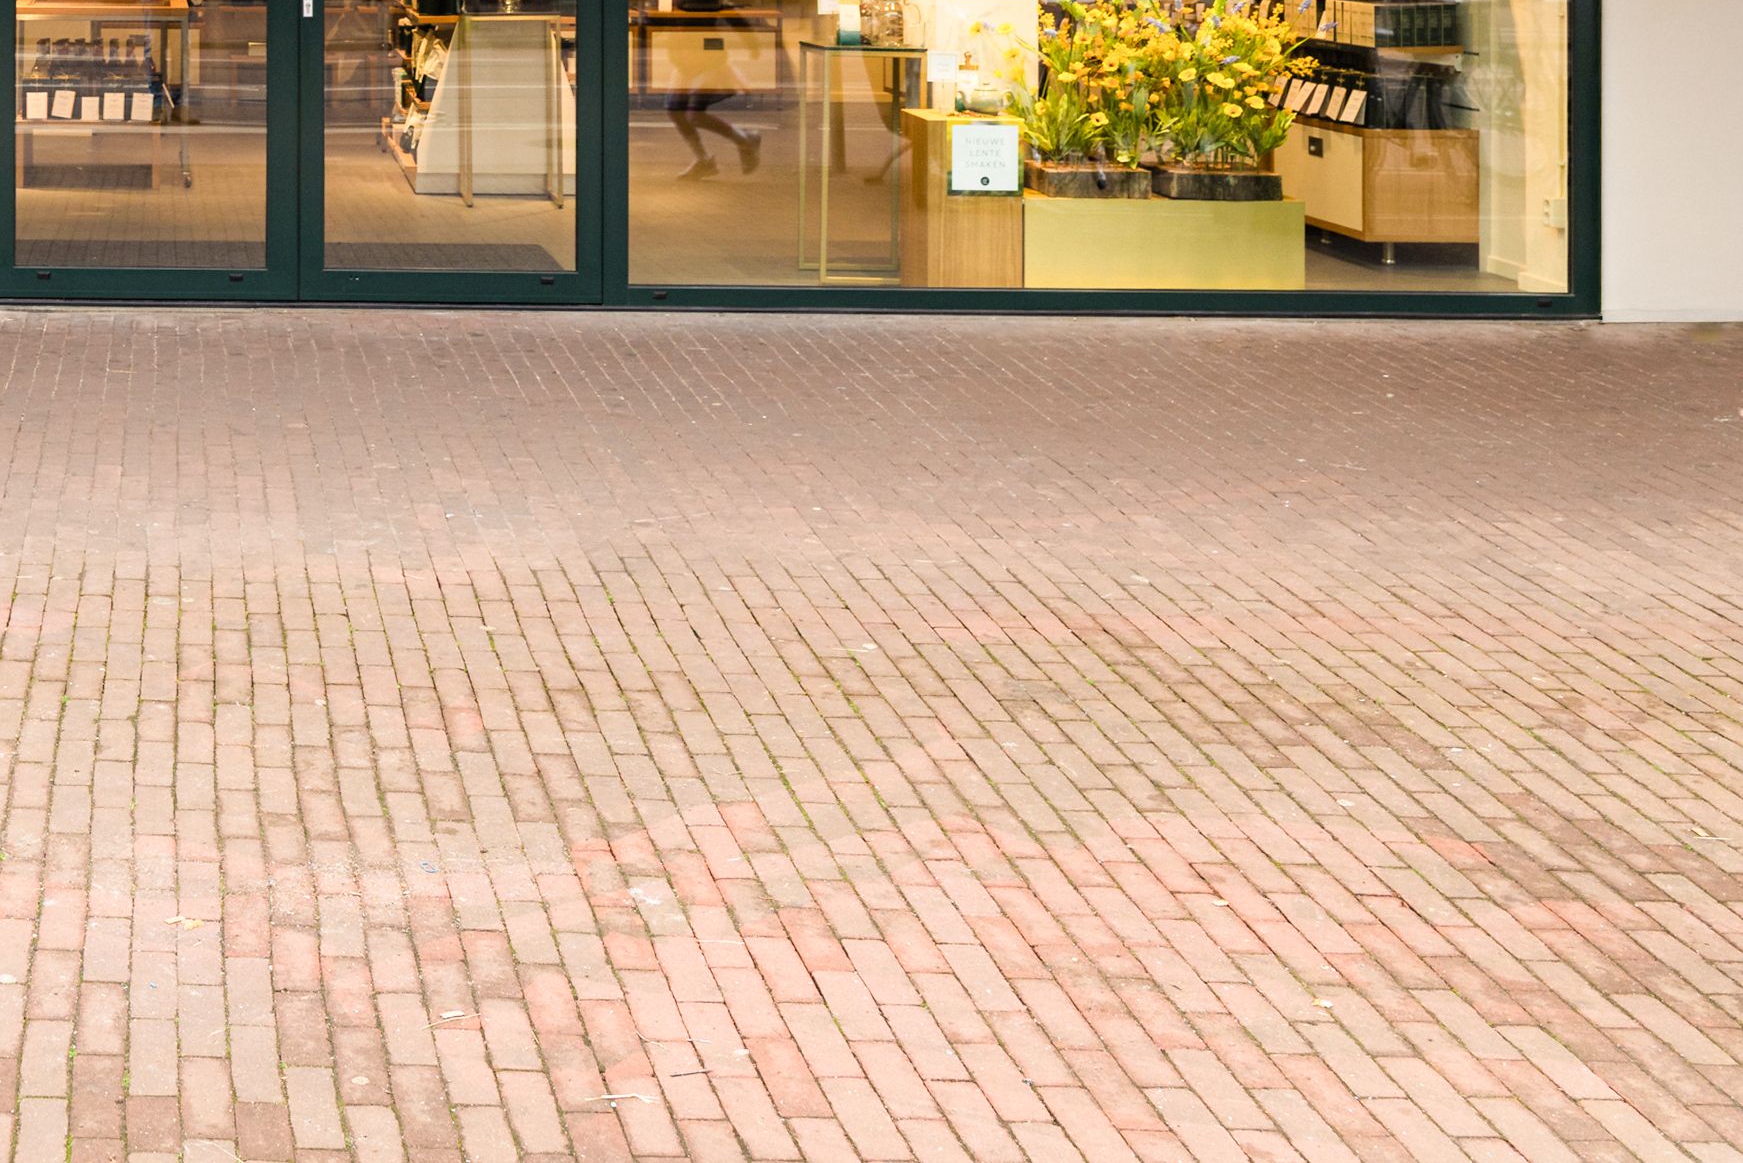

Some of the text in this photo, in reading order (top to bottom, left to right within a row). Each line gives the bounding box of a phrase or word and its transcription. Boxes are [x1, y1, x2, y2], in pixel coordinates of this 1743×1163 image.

[964, 137, 1006, 146] NIEUWE
[968, 149, 1001, 157] LENTE
[964, 160, 1006, 169] SMAKEN
